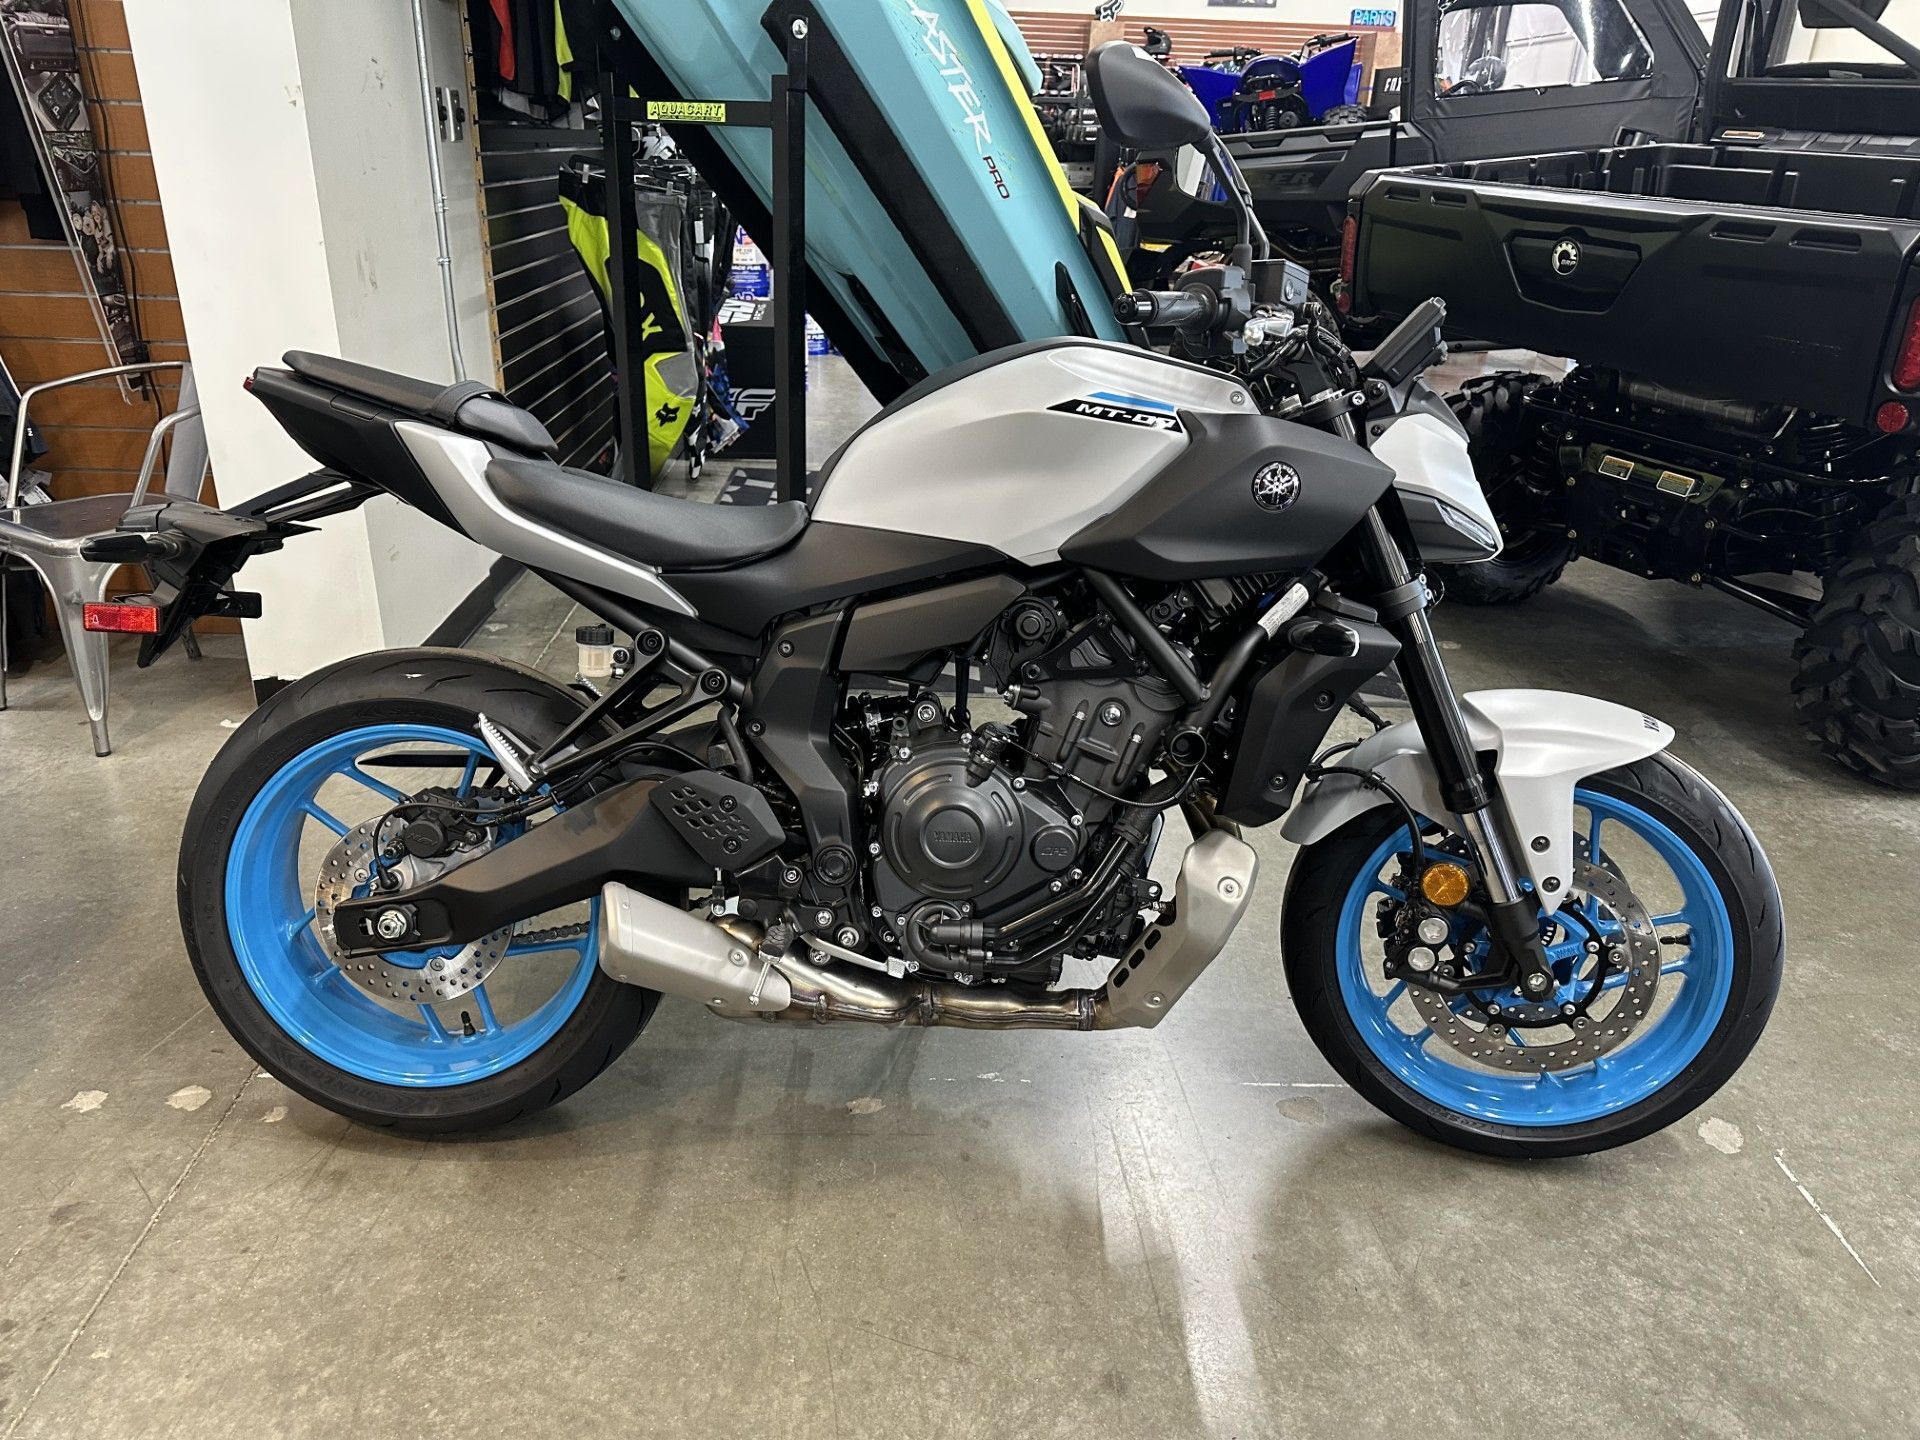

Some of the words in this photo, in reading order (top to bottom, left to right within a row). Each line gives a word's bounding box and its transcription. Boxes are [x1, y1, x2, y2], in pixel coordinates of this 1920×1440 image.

[1353, 10, 1395, 26] PARTS
[650, 102, 722, 116] AQUACART
[982, 155, 1010, 199] PRO
[934, 831, 972, 843] YAMAHA
